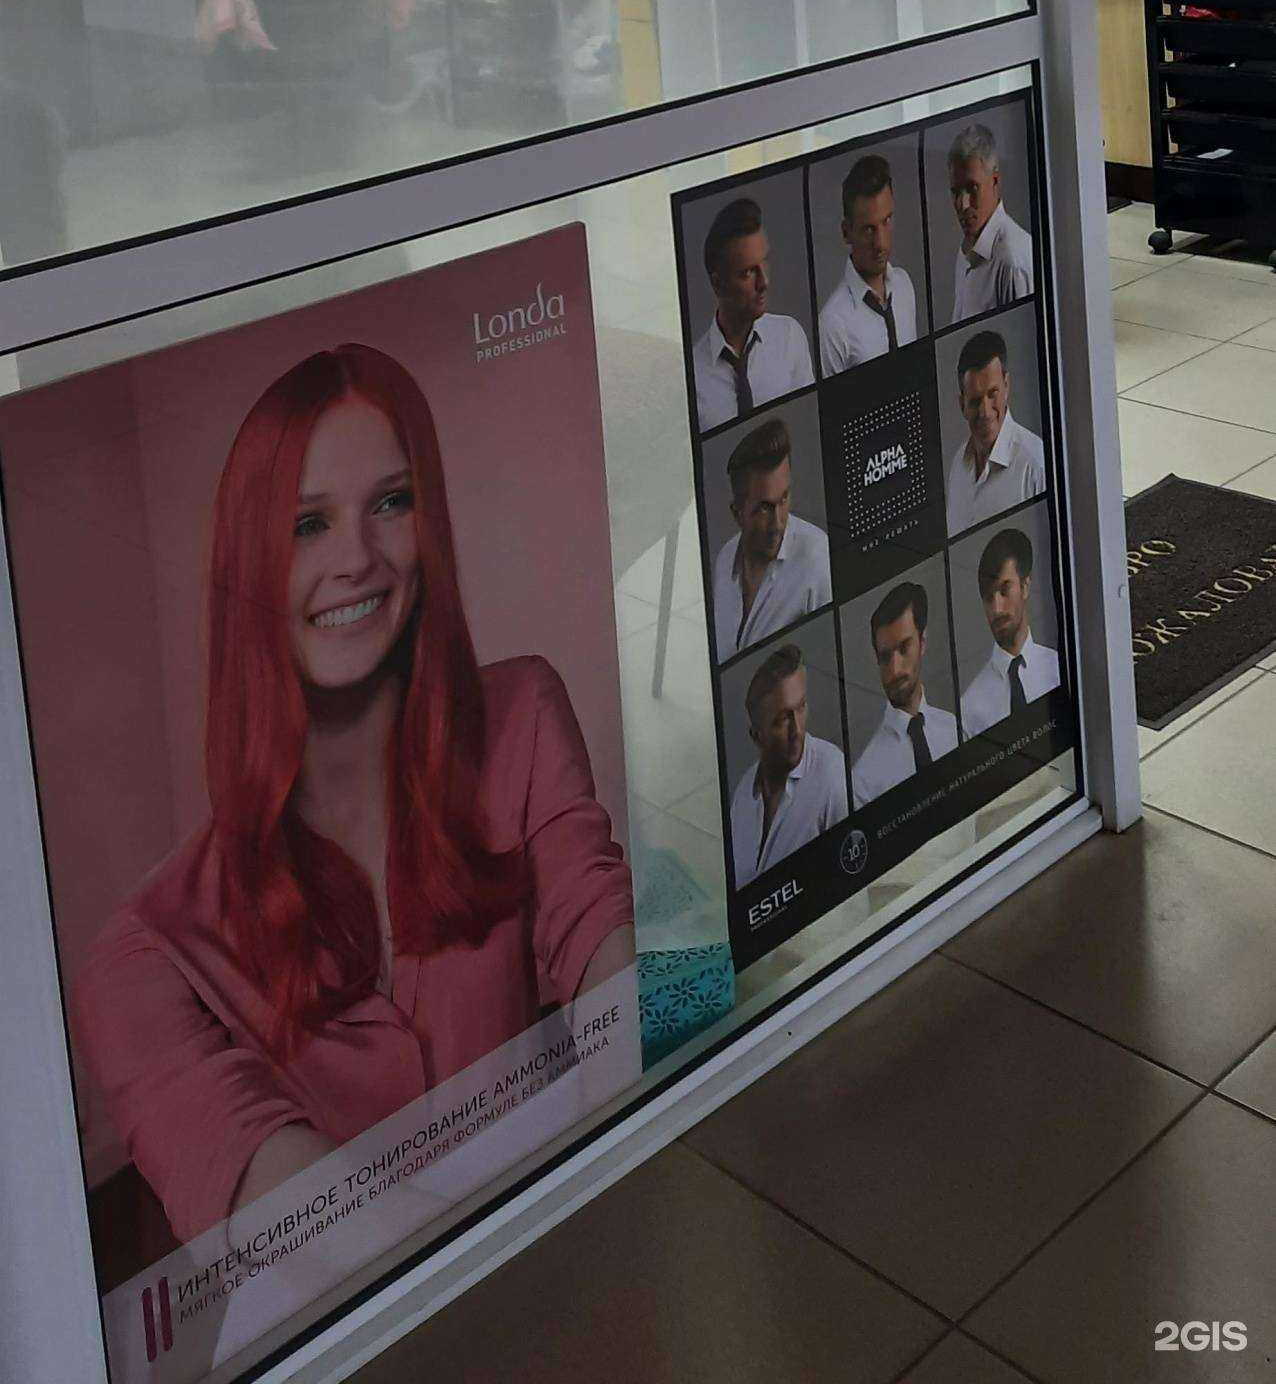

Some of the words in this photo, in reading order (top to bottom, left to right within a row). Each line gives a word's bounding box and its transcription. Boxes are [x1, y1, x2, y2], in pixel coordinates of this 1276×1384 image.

[473, 281, 565, 344] Londa
[476, 324, 567, 363] PROFESSIONAL
[864, 455, 908, 487] HOMME
[866, 444, 905, 472] ALPHA
[1006, 735, 1030, 755] ЦВЕТА
[1032, 719, 1057, 740] ВОЛОС
[749, 879, 804, 925] ESTEL
[178, 1186, 339, 1302] ИНТЕНСИВНОЕ
[344, 1090, 488, 1193] ТОНИРОВАНИЕ
[493, 1005, 621, 1099] AMMONIA-FREE
[180, 1271, 243, 1323] МЯГКОЕ
[248, 1194, 364, 1278] ОКРАШИВАНИЕ
[368, 1141, 450, 1200] БЛАГОДАРЯ
[453, 1095, 519, 1144] ФОРМУЛЕ
[521, 1077, 544, 1100] БЕЗ
